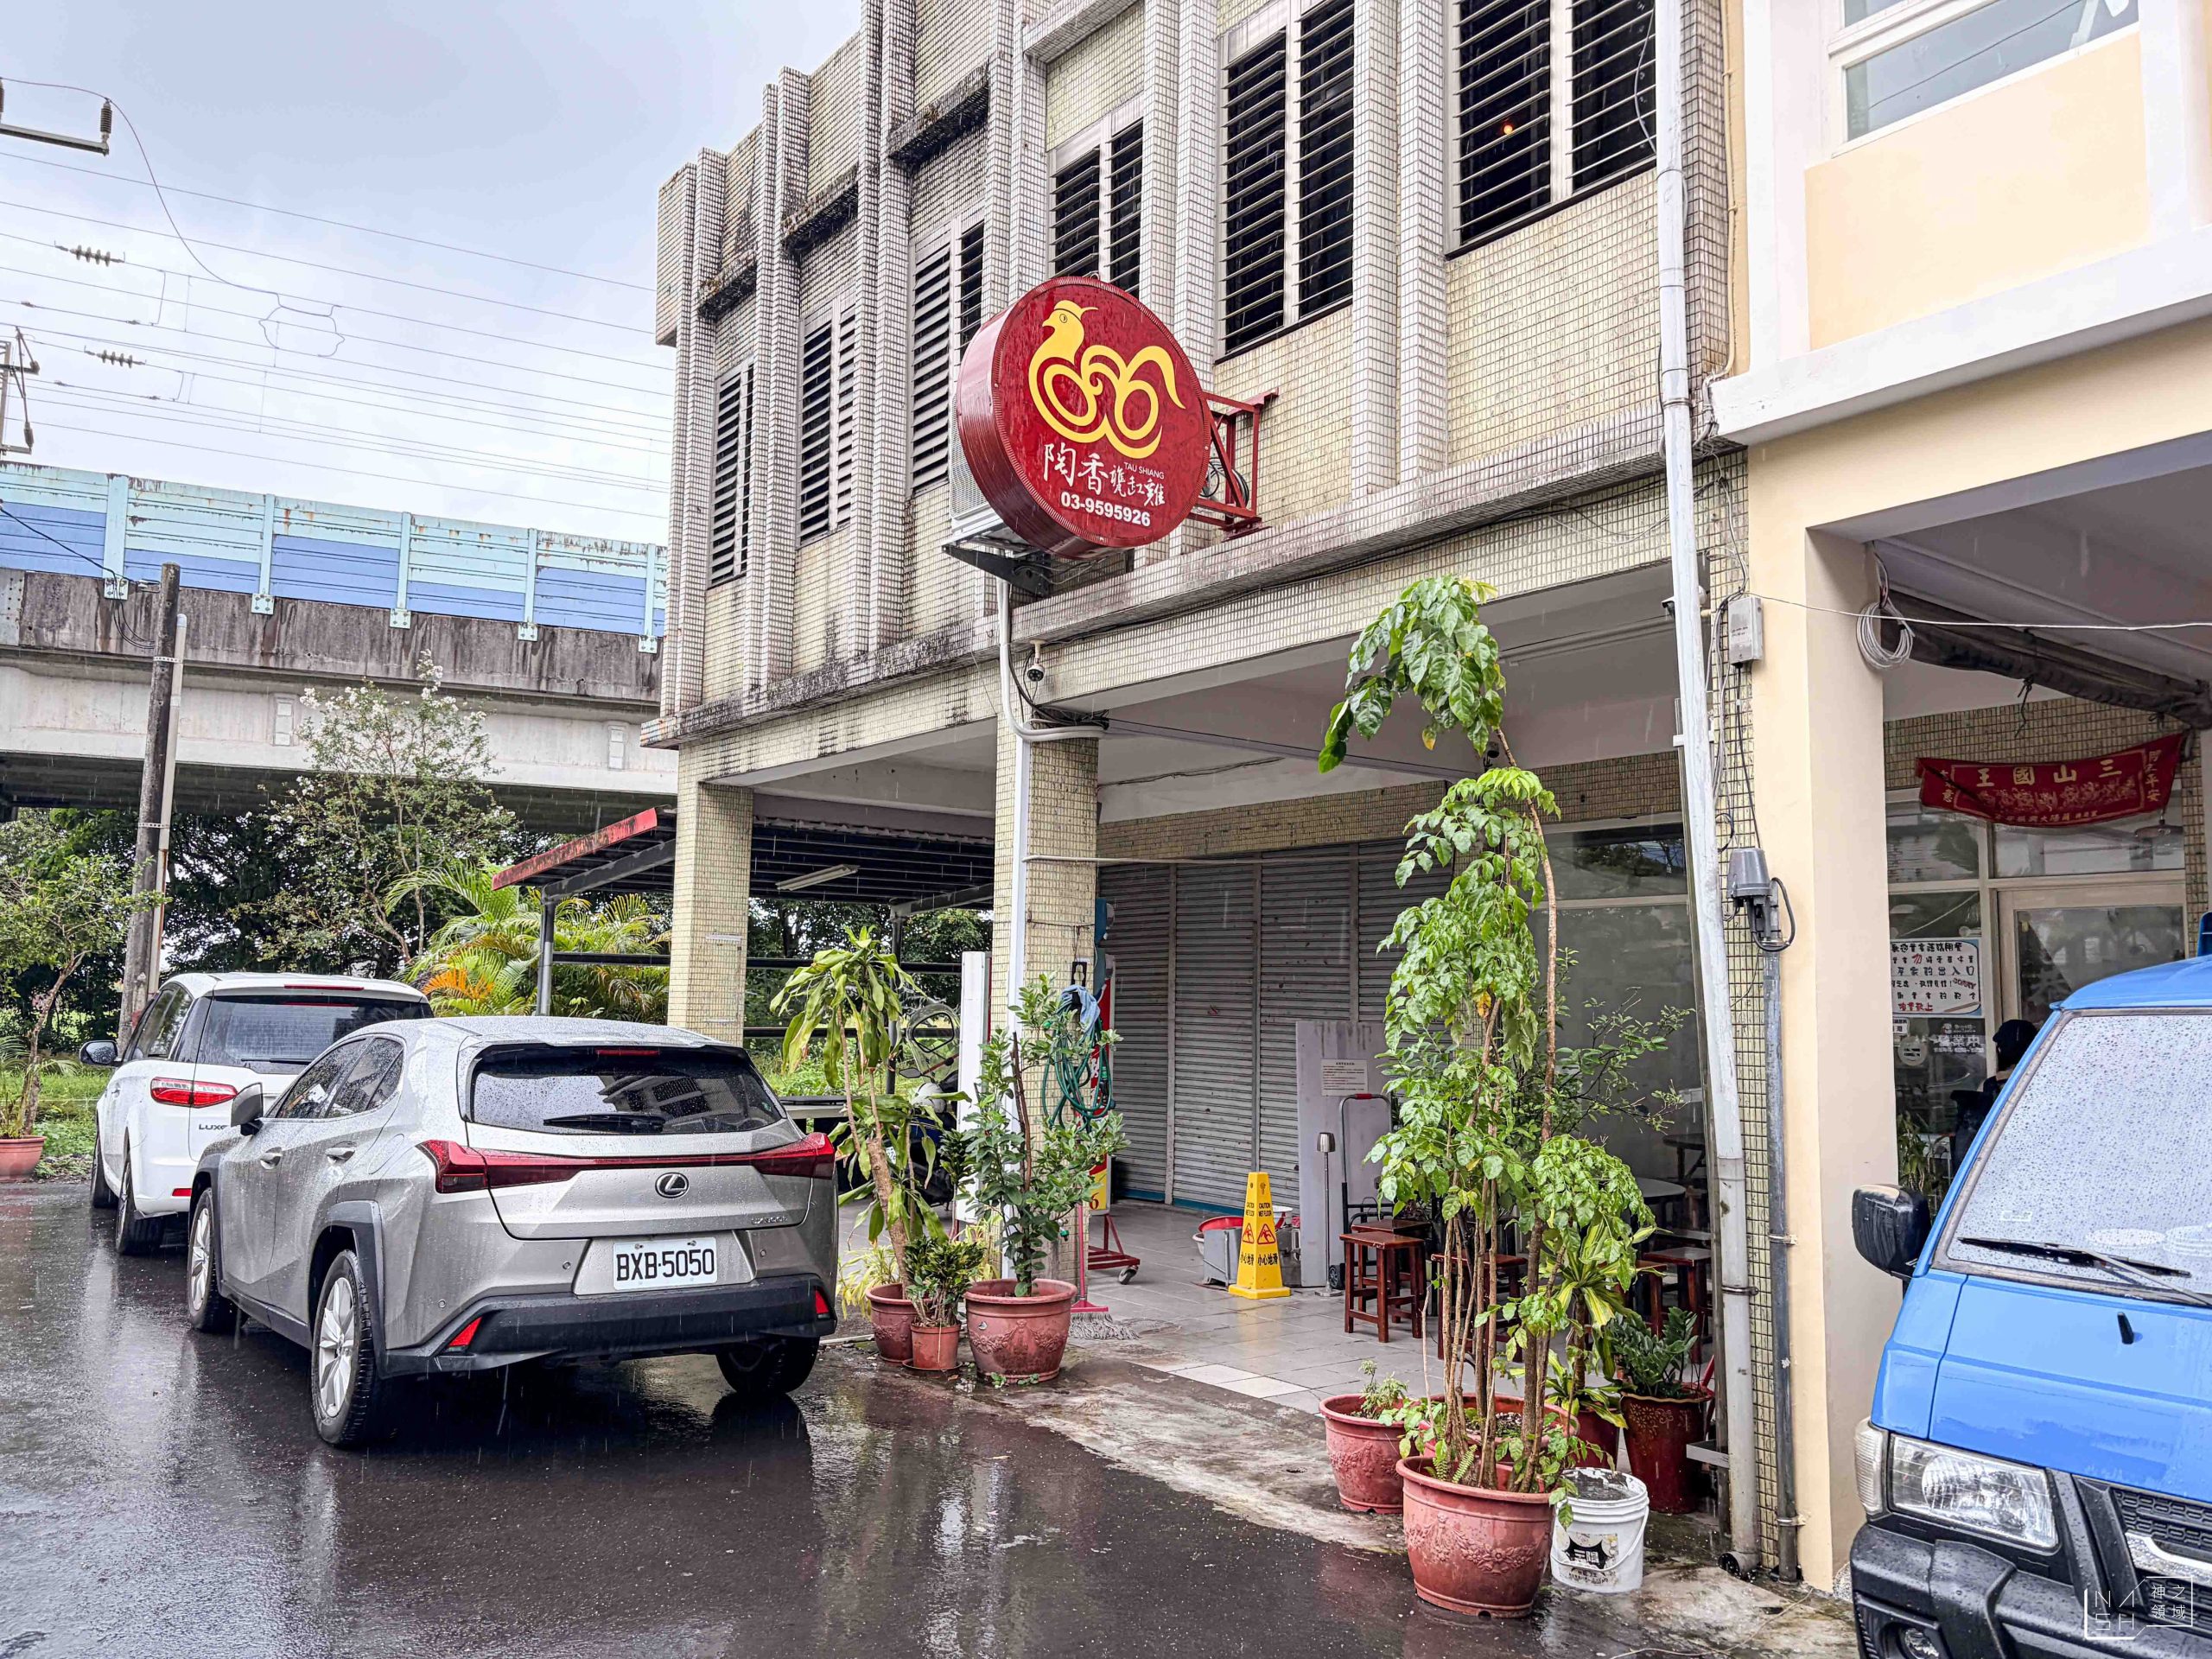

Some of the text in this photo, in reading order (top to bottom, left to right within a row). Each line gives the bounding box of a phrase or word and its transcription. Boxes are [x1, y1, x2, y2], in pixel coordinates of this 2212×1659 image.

[1123, 461, 1165, 480] TAU SHIANG
[1061, 491, 1151, 527] 03-9595926
